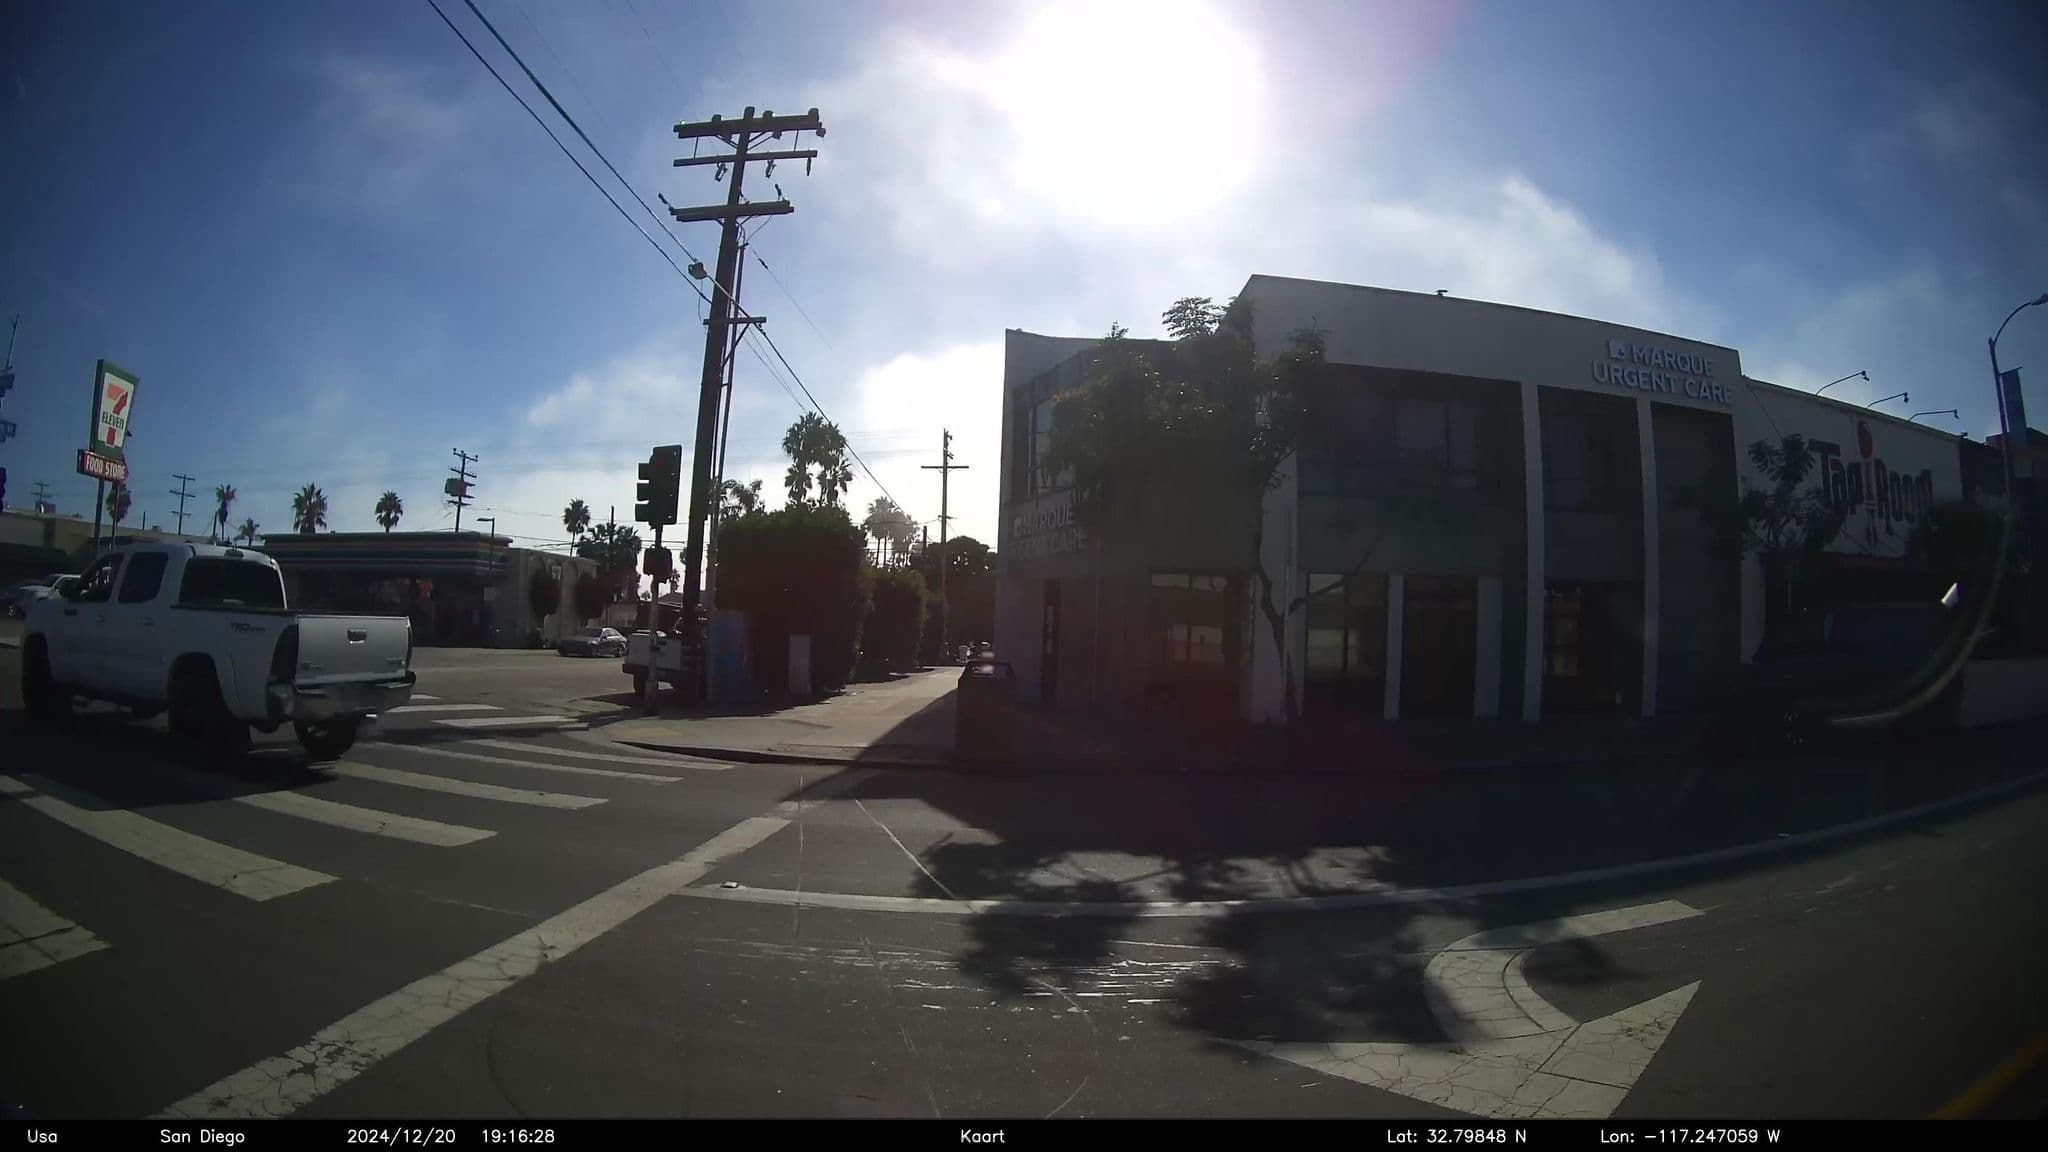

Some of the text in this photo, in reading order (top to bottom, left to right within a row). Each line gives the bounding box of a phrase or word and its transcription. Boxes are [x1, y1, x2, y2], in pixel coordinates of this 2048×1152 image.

[1631, 344, 1713, 376] MARQUE
[1592, 359, 1732, 404] URGENT CARE
[106, 382, 129, 445] 7
[86, 455, 126, 480] FOOD STORE
[1808, 439, 1933, 536] Tap Room
[1022, 504, 1073, 537] MARQUE
